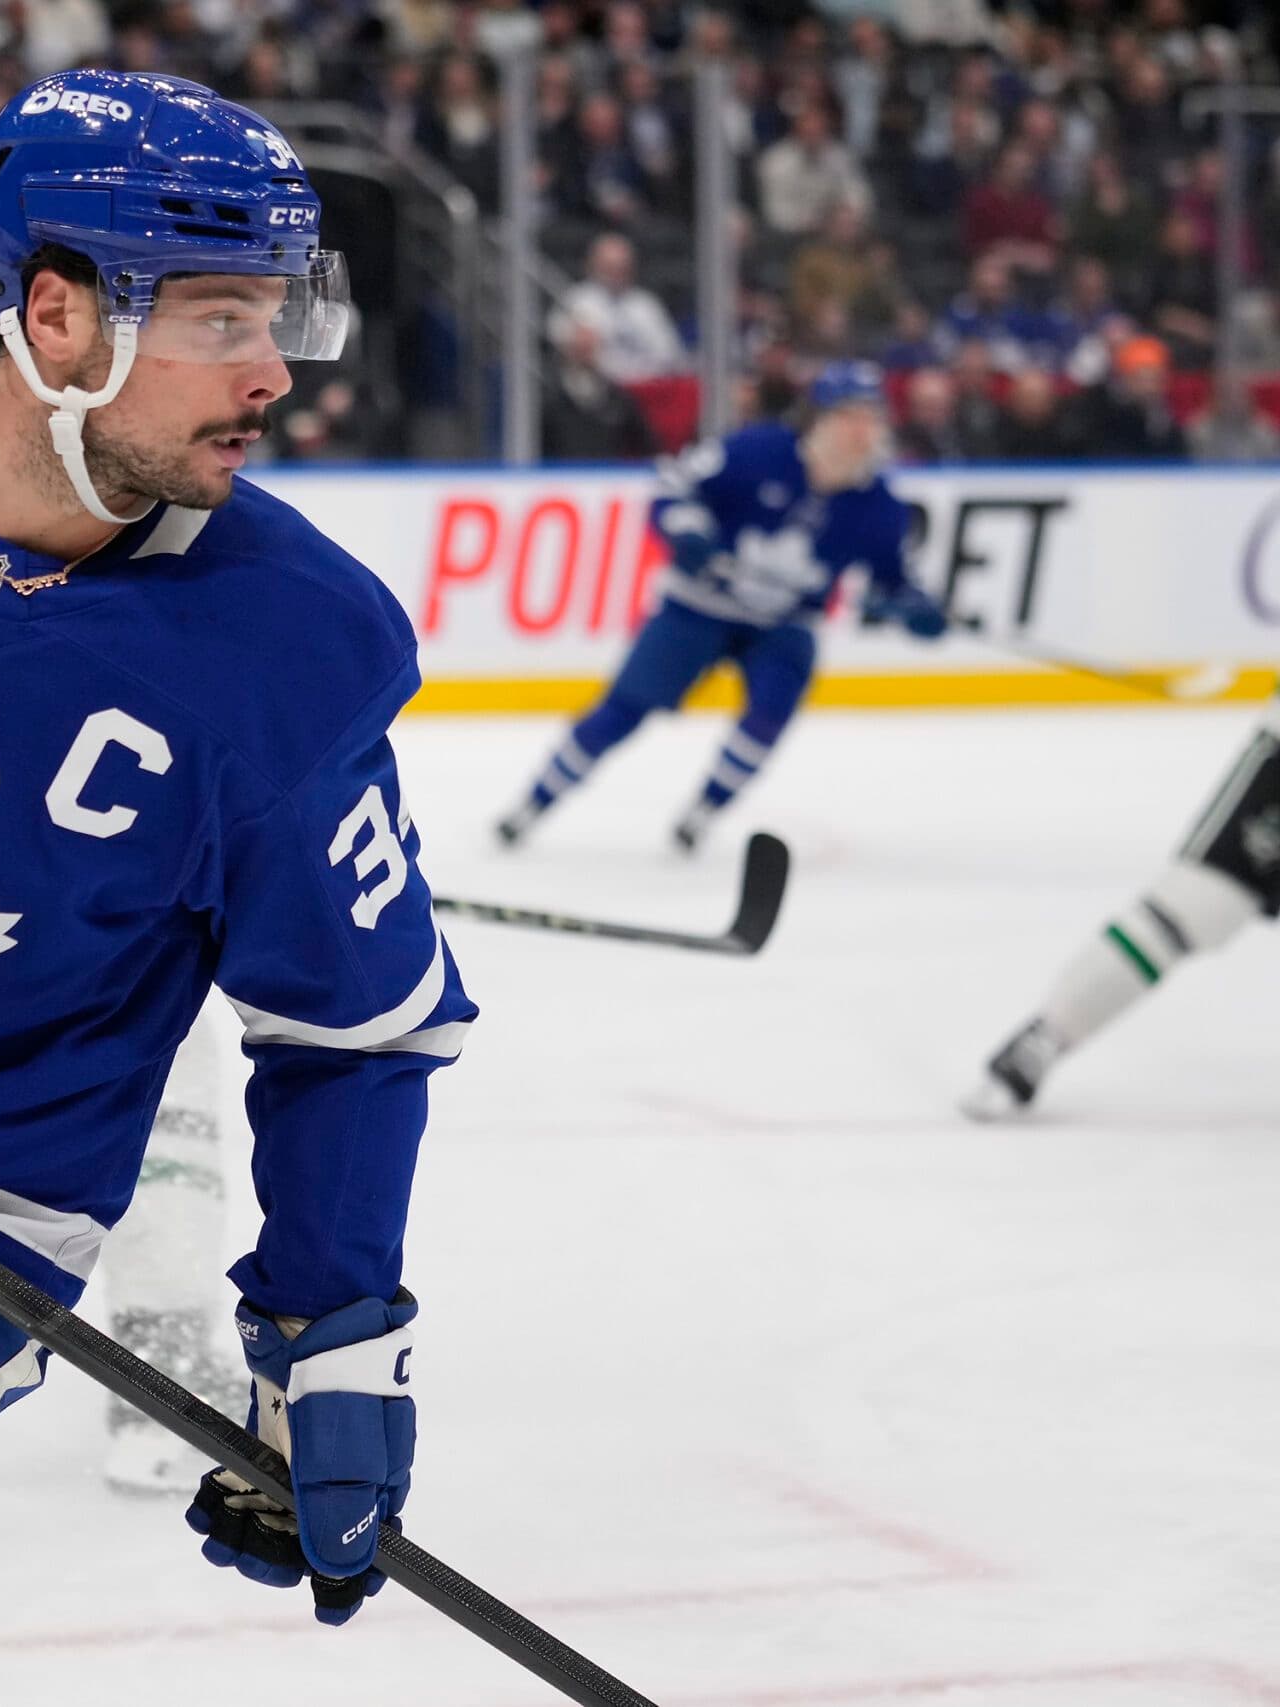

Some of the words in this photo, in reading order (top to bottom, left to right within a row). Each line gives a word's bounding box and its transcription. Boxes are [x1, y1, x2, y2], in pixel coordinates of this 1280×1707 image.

[20, 89, 133, 122] OREO
[269, 207, 316, 225] CCM
[108, 315, 142, 324] CCM
[45, 708, 173, 839] C
[342, 1503, 377, 1544] CCM
